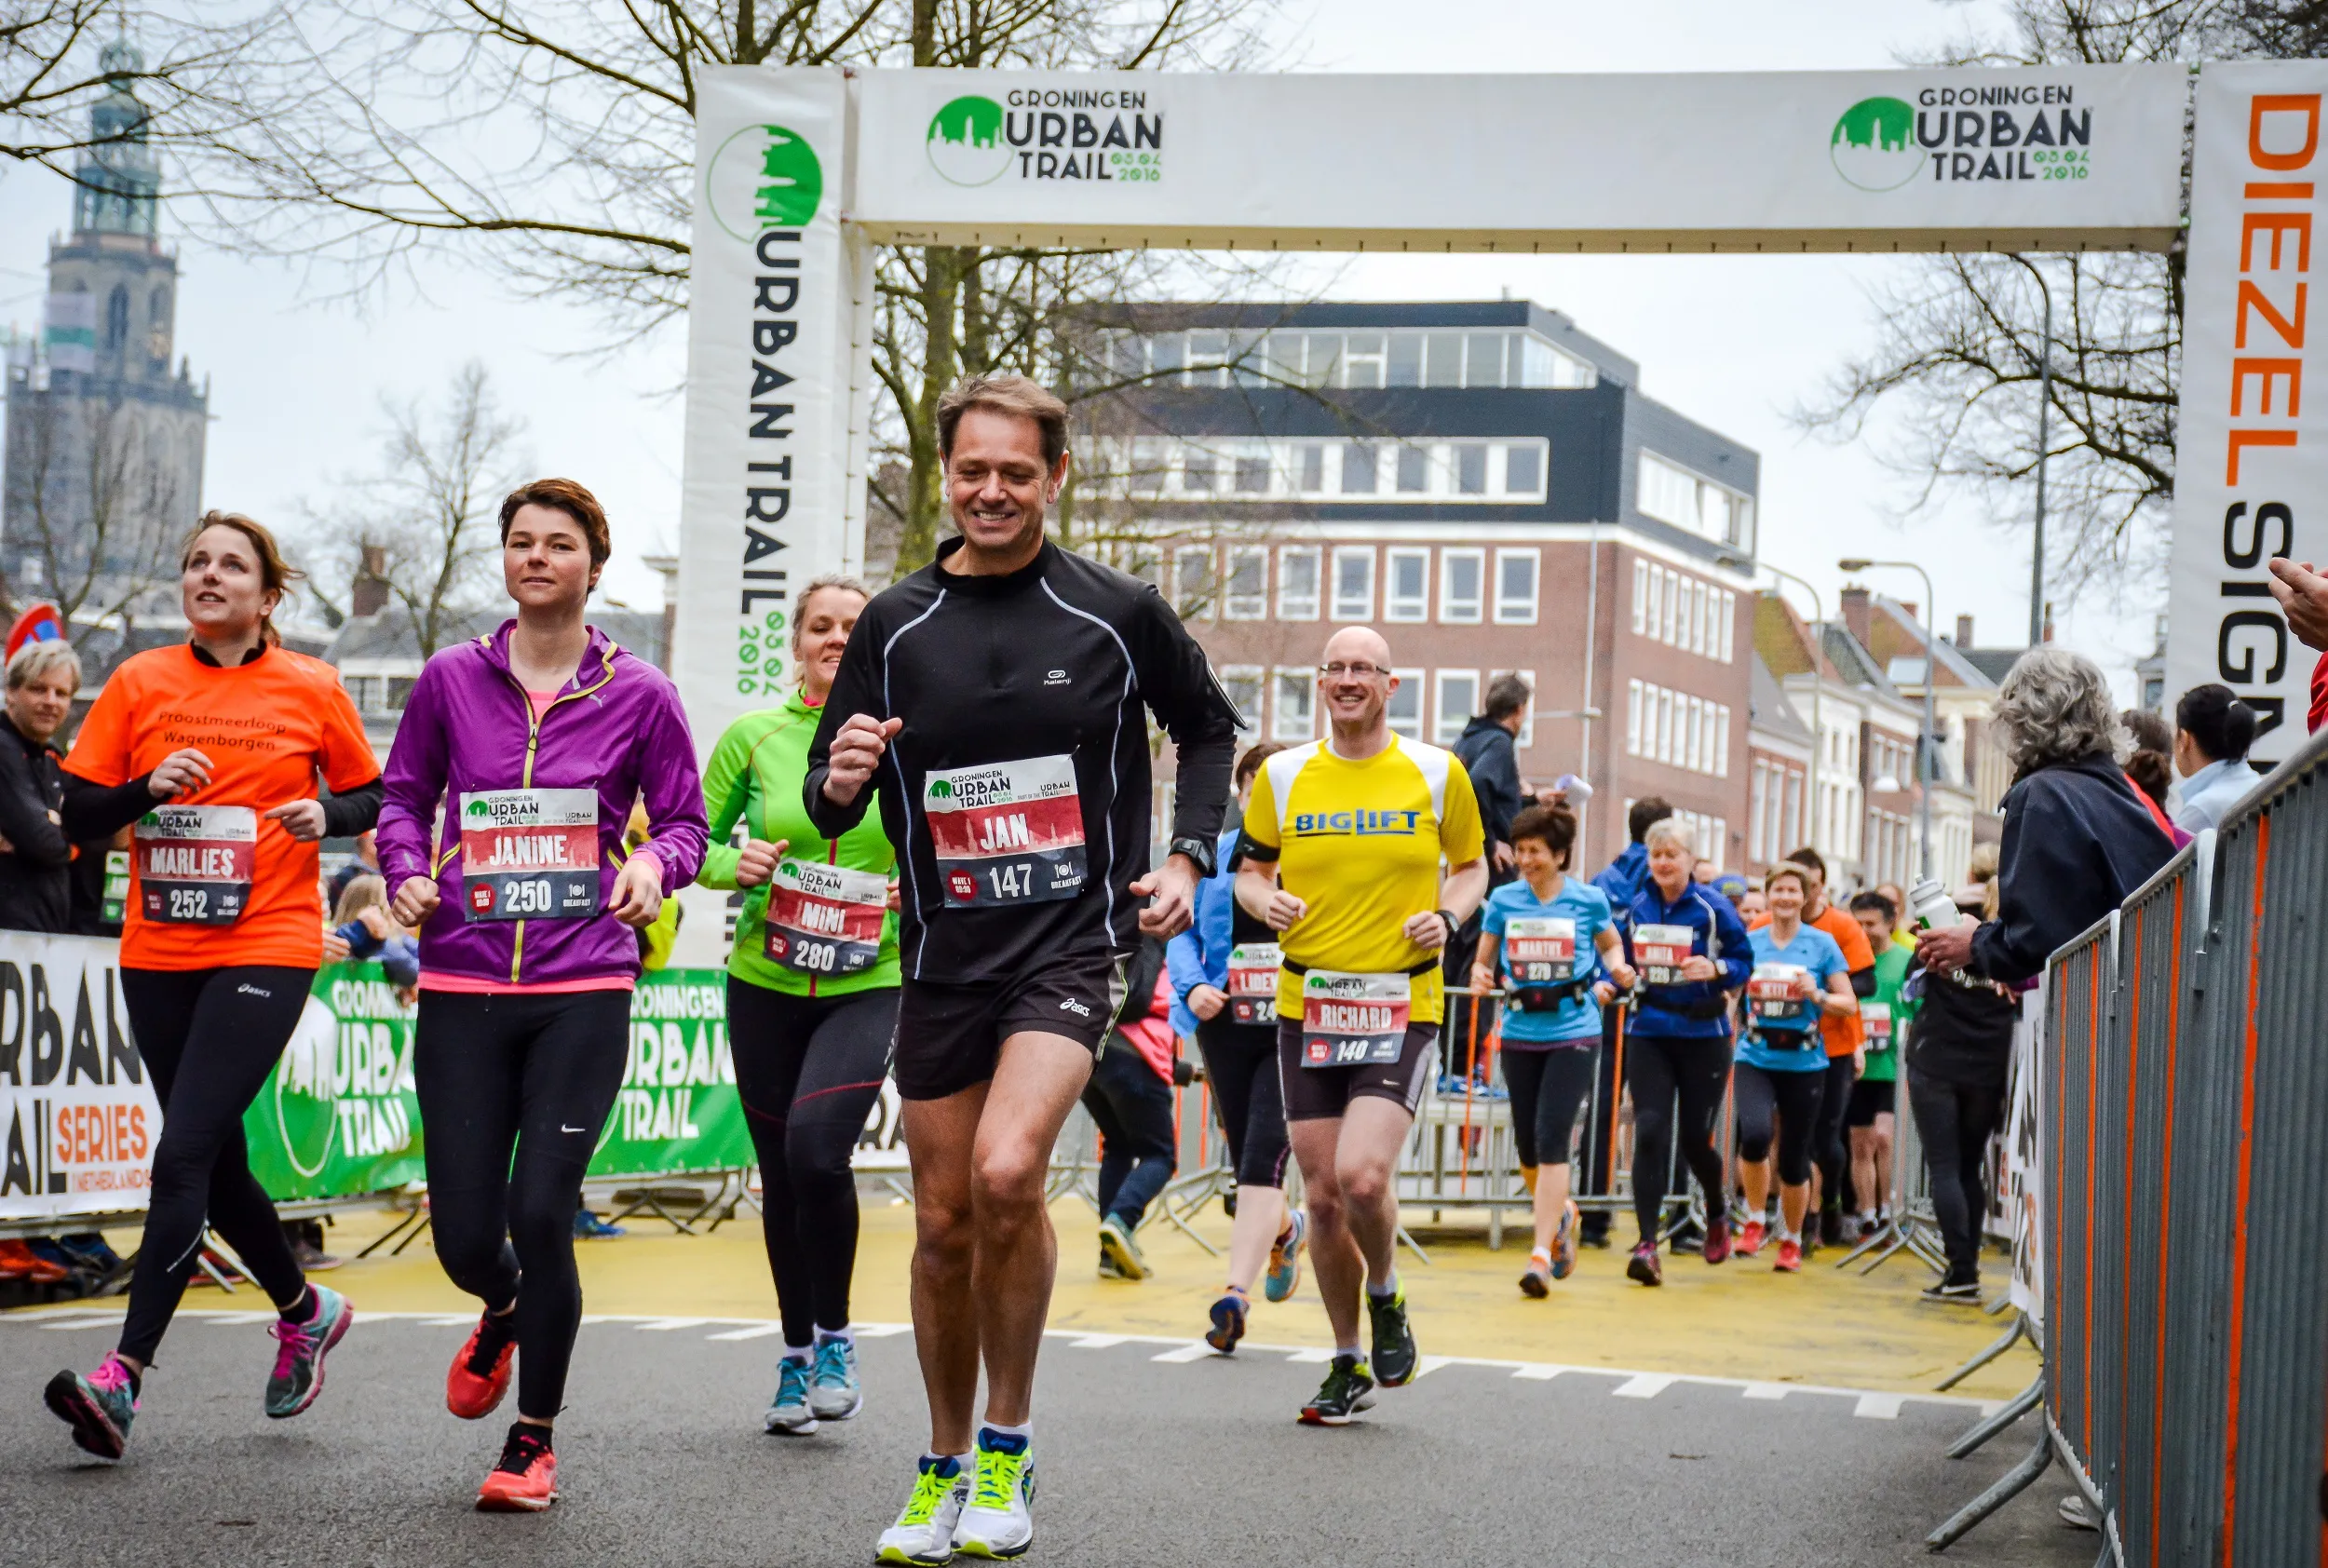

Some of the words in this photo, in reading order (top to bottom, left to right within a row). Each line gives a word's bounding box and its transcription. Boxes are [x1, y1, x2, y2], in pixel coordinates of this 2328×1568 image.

[1008, 90, 1146, 109] GRONINGEN
[1918, 86, 2073, 107] GRONINGEN
[1006, 112, 1162, 149] URBAN
[1916, 108, 2091, 148] URBAN
[1019, 151, 1112, 181] TRAIL
[1119, 168, 1161, 181] 2016
[1931, 151, 2036, 181] TRAIL
[2043, 166, 2089, 180] 2016
[2226, 94, 2321, 486] DIEZEL
[749, 232, 802, 439] URBAN
[741, 455, 792, 615] TRAIL
[737, 625, 761, 696] 2016
[158, 711, 286, 734] Proostmeerloop
[164, 731, 276, 751] Wagenborgen
[951, 769, 1003, 783] GRONINGEN
[952, 777, 1010, 797] URBAN
[1040, 781, 1070, 791] URBAN
[489, 803, 539, 816] URBAN
[959, 794, 995, 808] TRAIL
[495, 816, 523, 826] TRAIL
[981, 813, 1030, 850] JAN
[798, 870, 842, 889] URBAN
[989, 863, 1033, 899] 147
[170, 889, 209, 918] 252
[505, 880, 552, 912] 250
[793, 940, 836, 971] 280
[631, 984, 725, 1019] RONINGEN
[1255, 1000, 1279, 1021] 24
[0, 959, 142, 1086] RBAN
[1320, 1004, 1392, 1029] RICHARD
[332, 1022, 417, 1095] URBA
[1336, 1039, 1369, 1062] 140
[622, 1088, 699, 1142] TRAIL
[57, 1104, 149, 1164] SERIES
